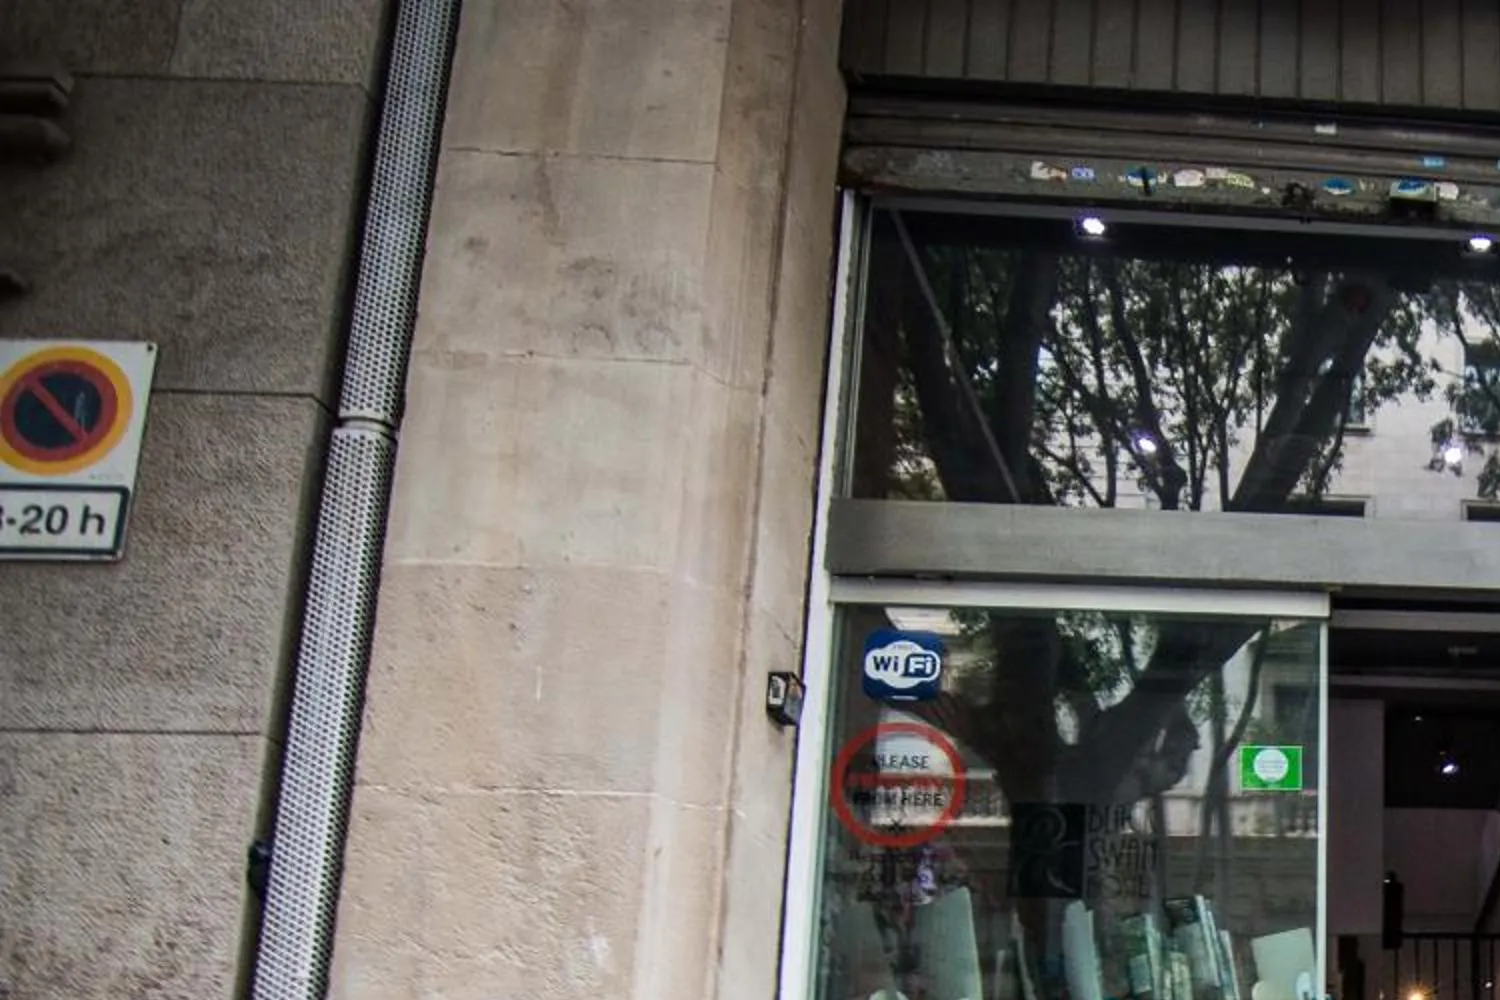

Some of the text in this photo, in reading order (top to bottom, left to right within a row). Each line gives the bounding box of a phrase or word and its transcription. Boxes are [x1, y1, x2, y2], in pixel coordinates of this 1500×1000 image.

[0, 504, 105, 535] -20 h
[871, 755, 930, 769] LEASE
